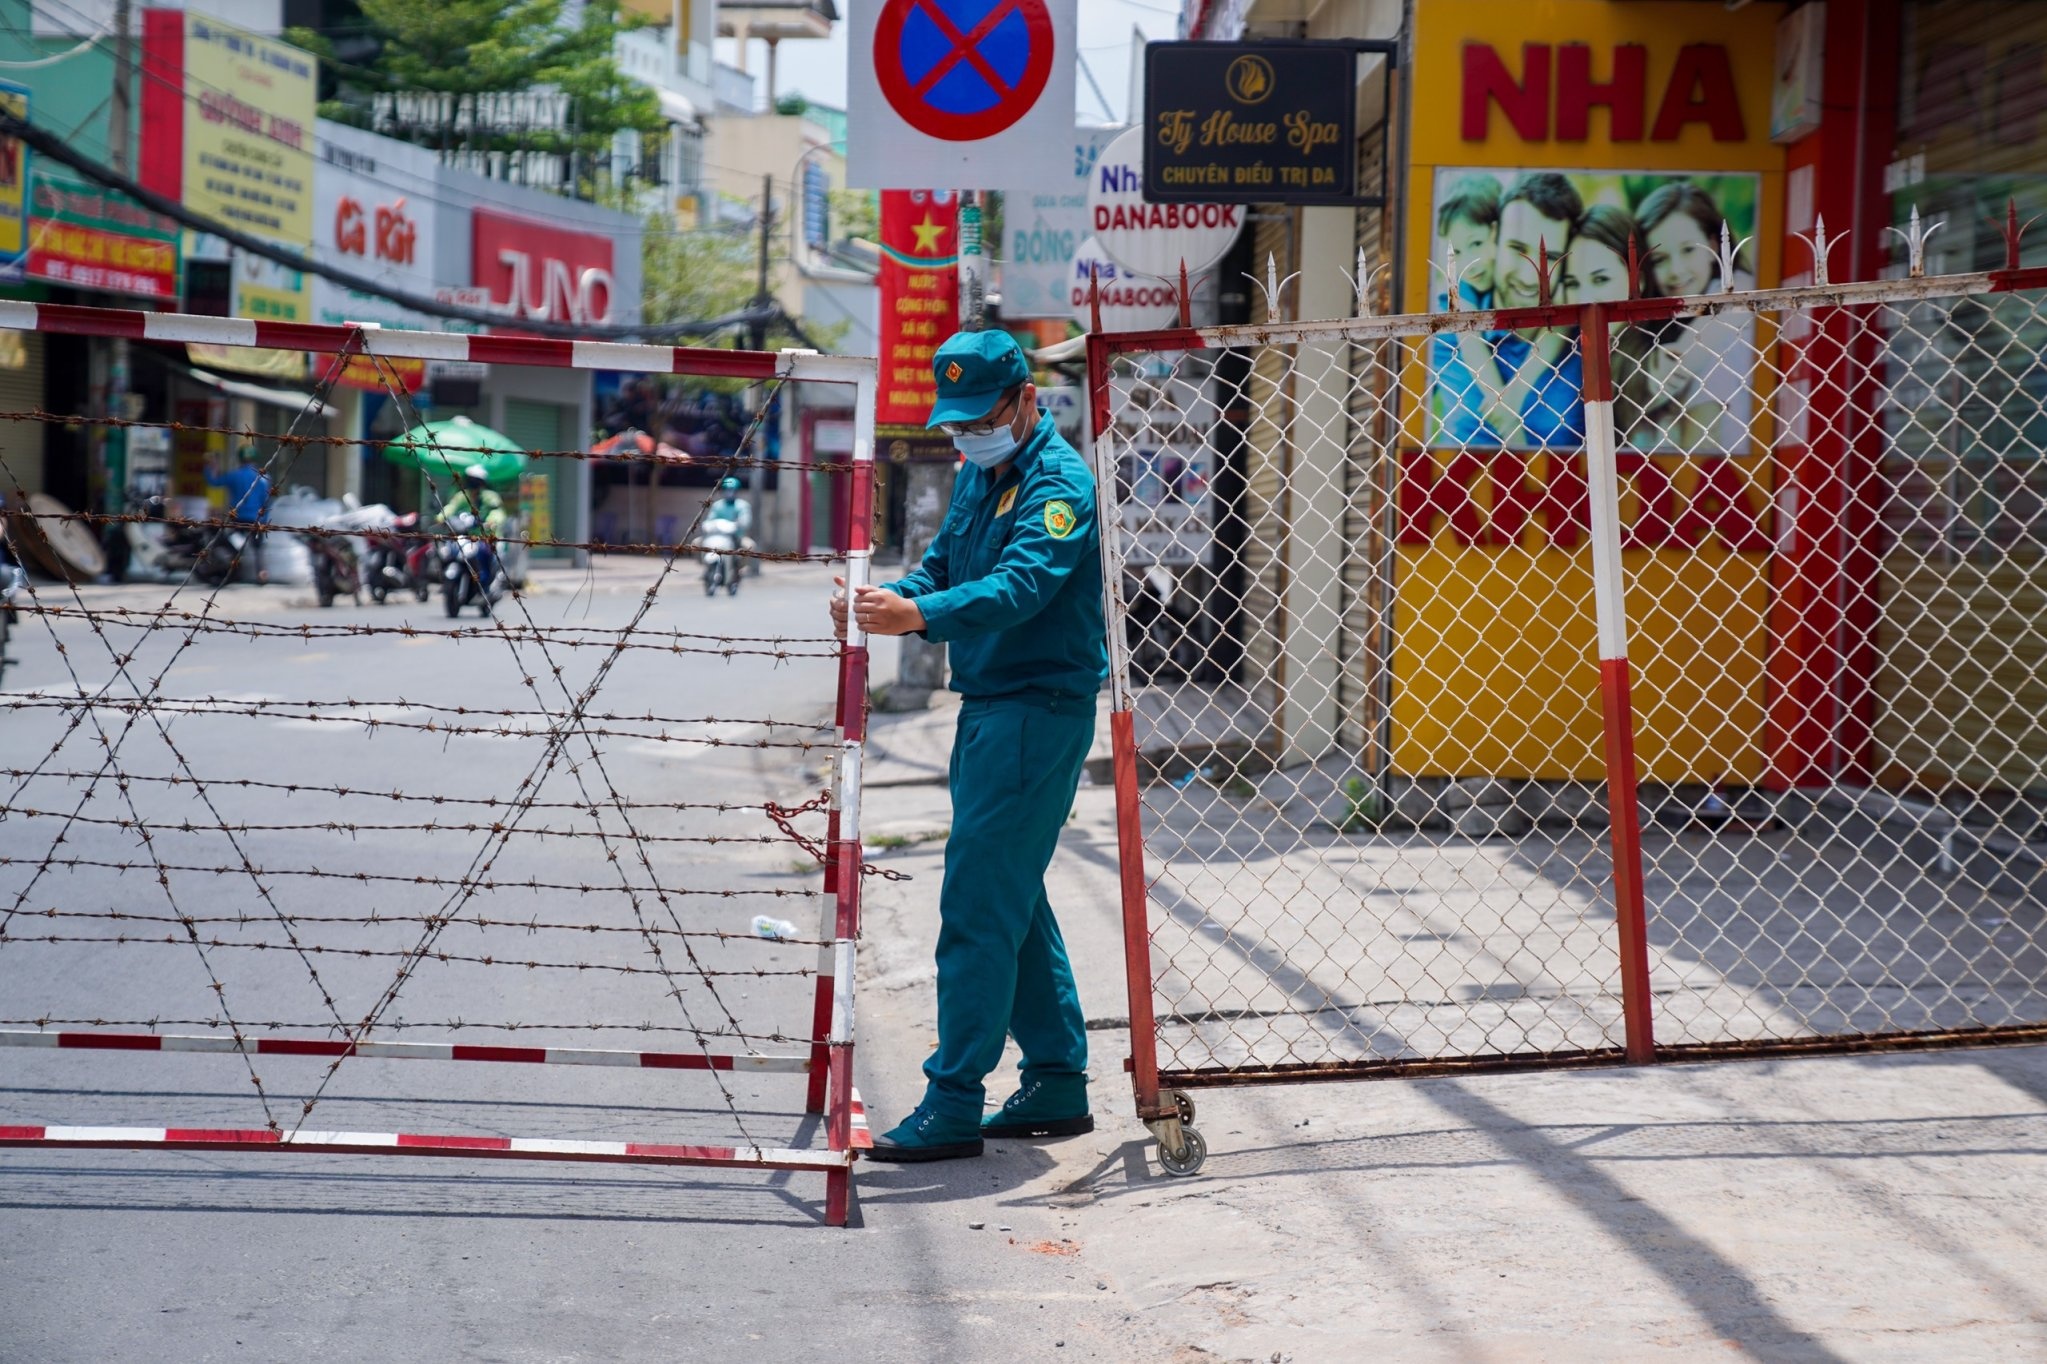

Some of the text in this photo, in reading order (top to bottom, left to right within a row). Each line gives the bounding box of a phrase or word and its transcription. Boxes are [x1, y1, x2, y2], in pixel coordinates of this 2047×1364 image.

[1461, 43, 1747, 142] NHA
[1158, 109, 1339, 155] Ty House Spa
[1162, 161, 1229, 184] CHUYÊN
[1095, 204, 1238, 231] DANABOOK
[490, 249, 613, 327] JUNO
[1072, 287, 1177, 307] DANABOOK
[1400, 452, 1771, 551] KHOA
